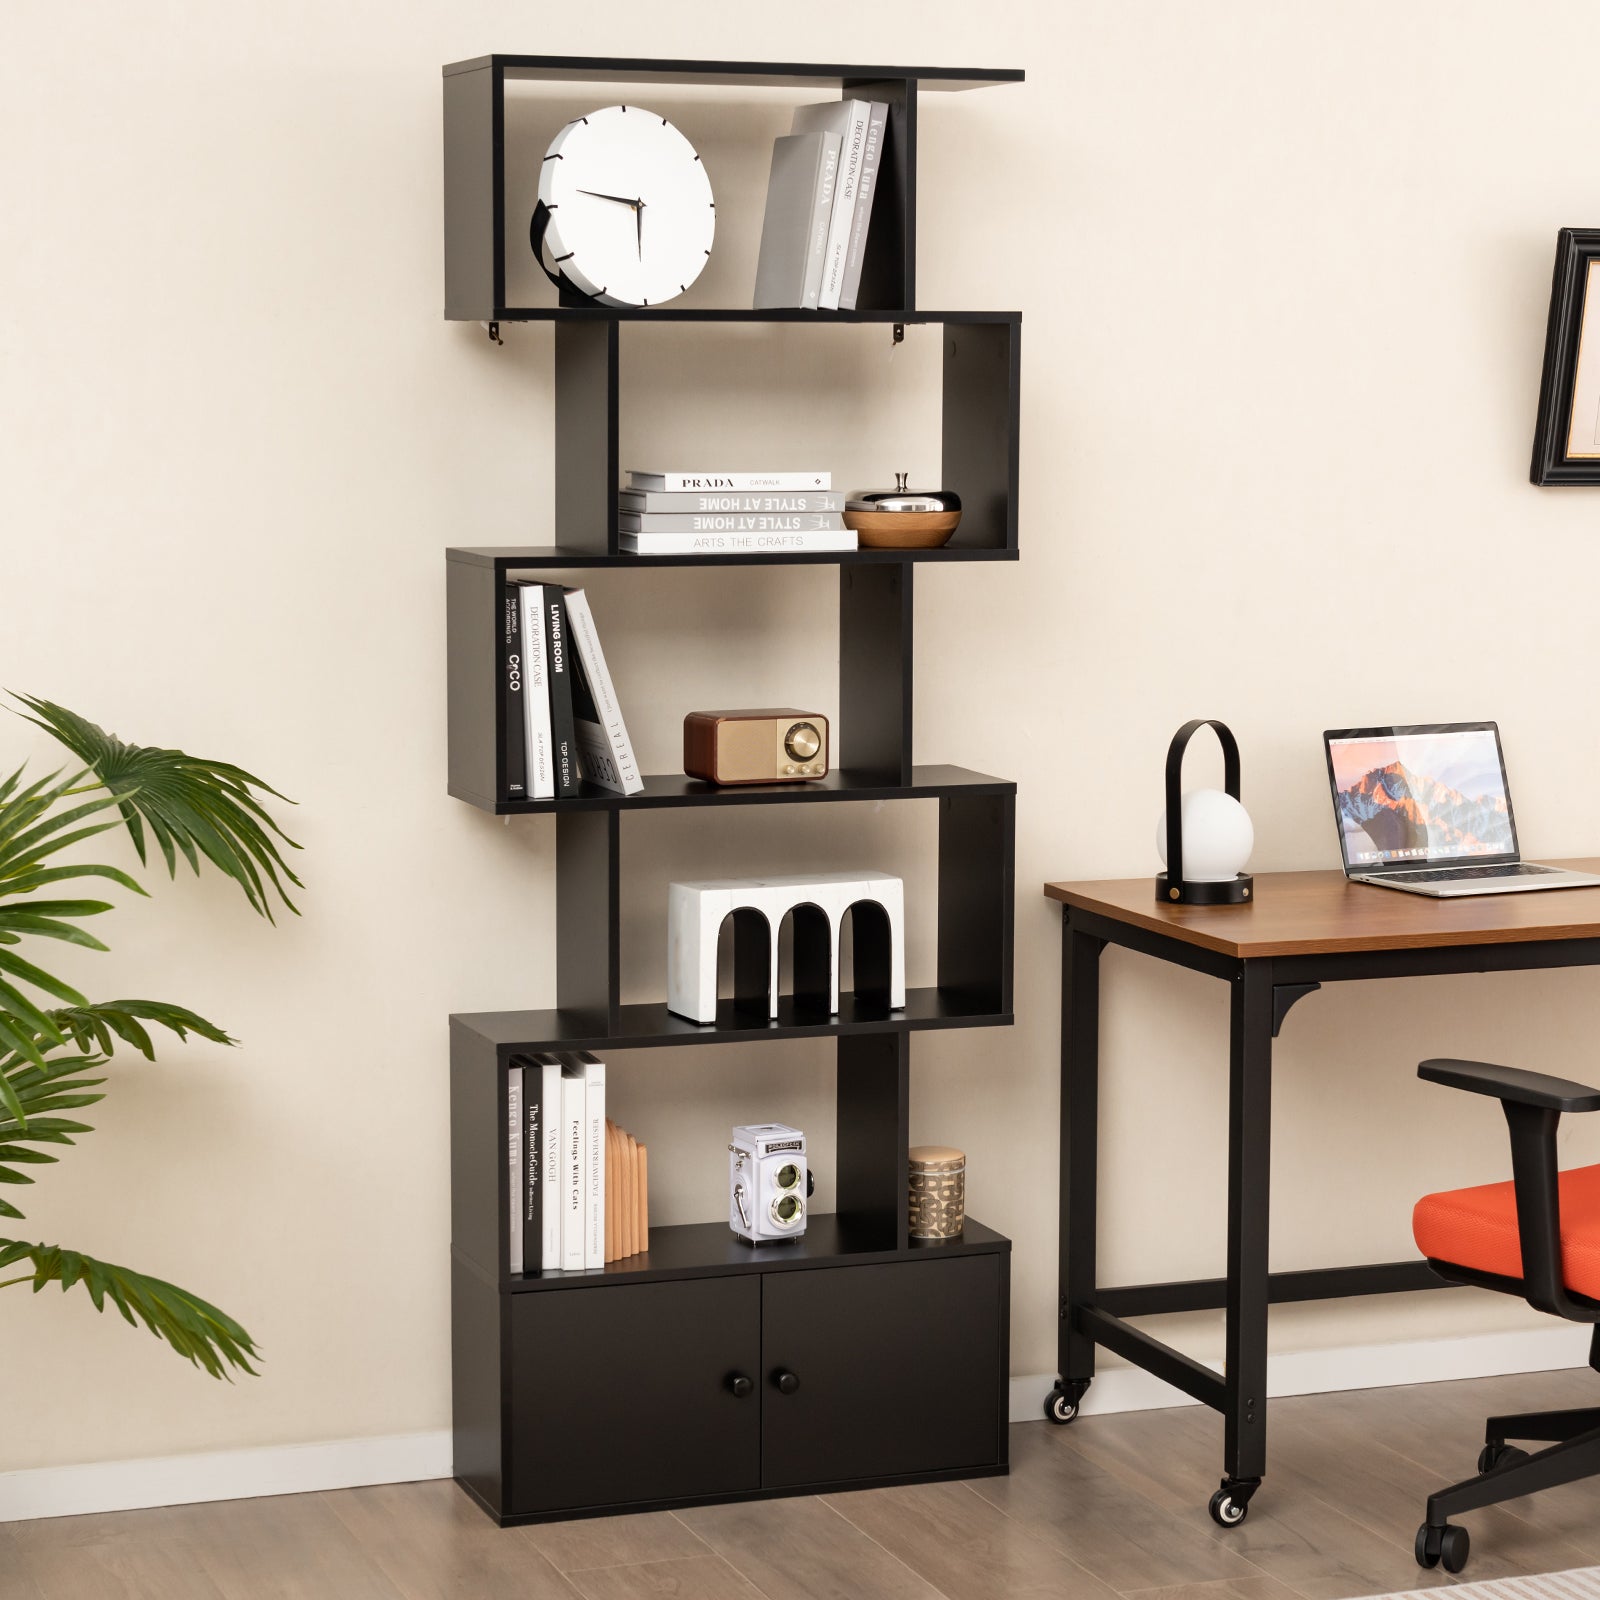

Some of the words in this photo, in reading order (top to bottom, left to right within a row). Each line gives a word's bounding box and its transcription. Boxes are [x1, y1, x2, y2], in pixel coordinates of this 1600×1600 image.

[849, 120, 864, 176] DECORATION
[866, 120, 882, 161] Kengo
[821, 150, 836, 205] PRADA
[859, 168, 875, 200] Kuma
[682, 478, 734, 488] PRADA
[699, 498, 740, 510] HOME
[744, 498, 760, 510] AT
[766, 498, 806, 510] STYLE
[693, 518, 735, 530] HOME
[738, 517, 754, 530] AT
[760, 517, 800, 530] STYLE
[693, 538, 725, 548] ARTS
[730, 538, 752, 547] THE
[758, 536, 804, 547] CRAFTS
[530, 606, 541, 664] DECORATION
[550, 604, 560, 640] LIVING
[554, 640, 564, 673] ROOM
[534, 664, 542, 688] CASE
[610, 722, 634, 780] CEREAL
[562, 758, 570, 787] DESIGN
[508, 1086, 520, 1126] Kengo
[529, 1104, 538, 1121] The
[509, 1132, 520, 1165] Kuma
